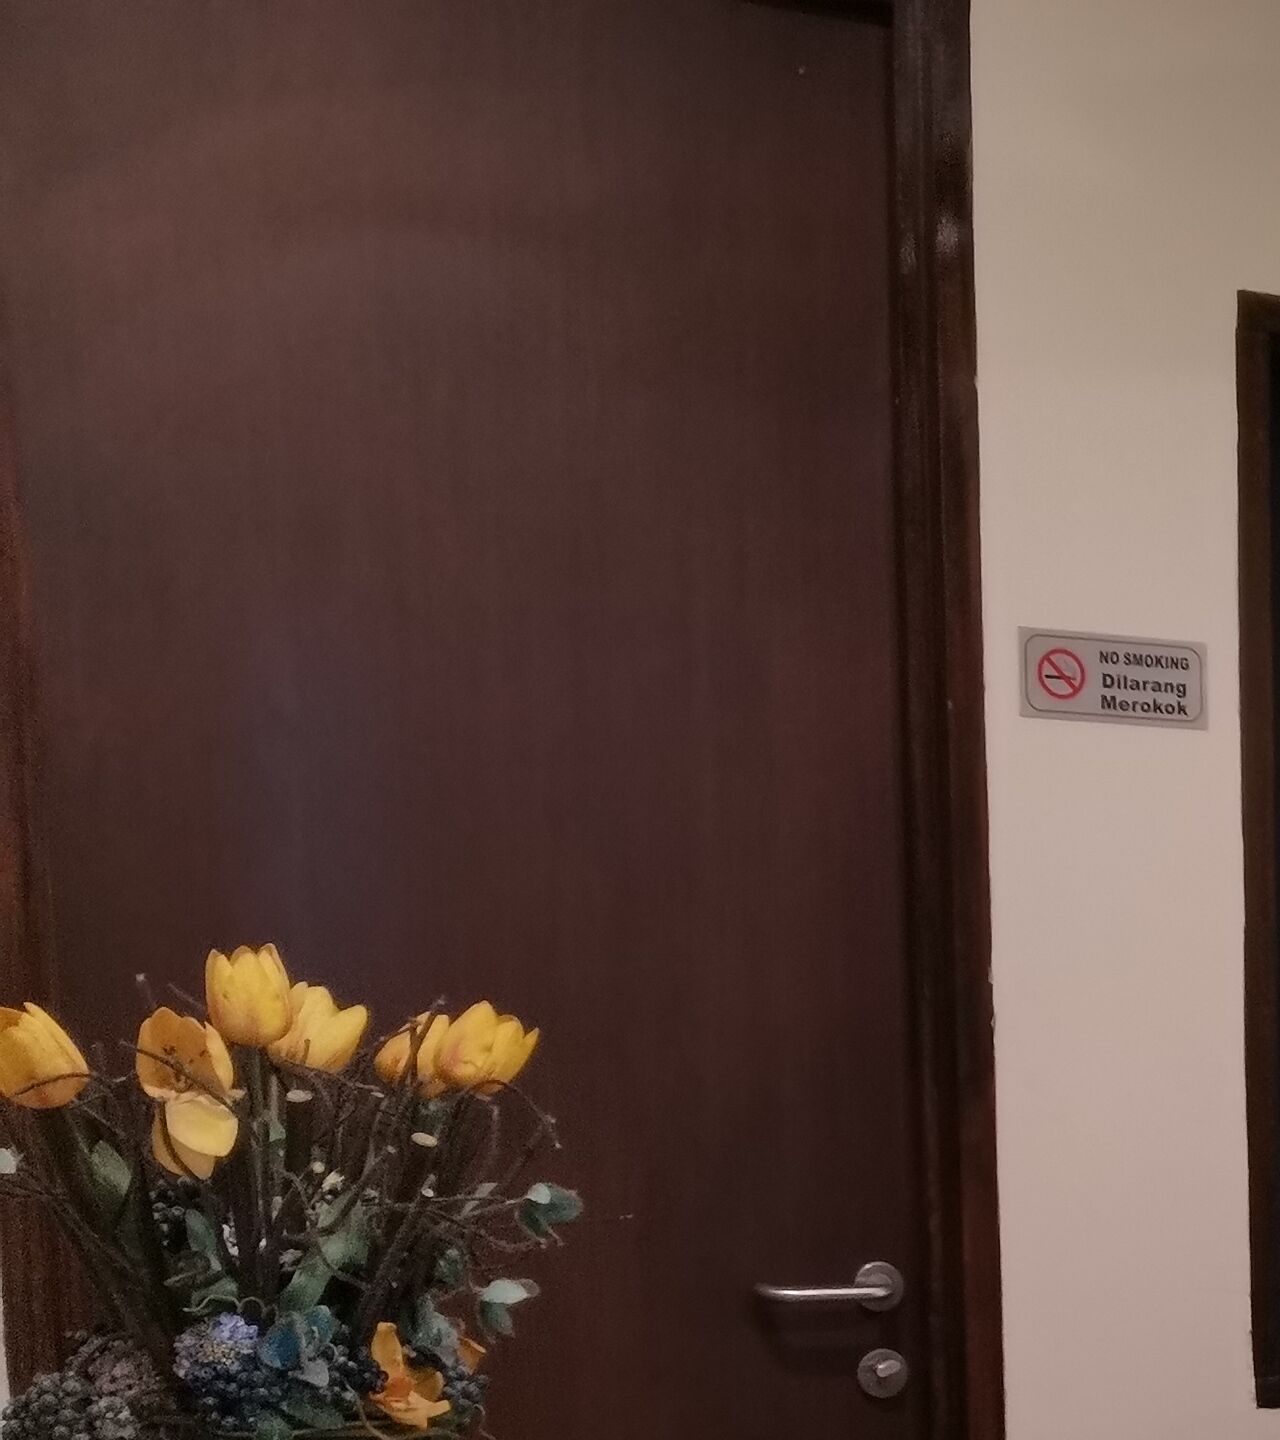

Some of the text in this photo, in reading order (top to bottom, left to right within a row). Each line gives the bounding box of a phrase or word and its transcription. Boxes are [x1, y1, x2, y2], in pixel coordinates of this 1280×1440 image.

[1099, 651, 1190, 671] NO SMOKING
[1102, 673, 1188, 698] Dilarang
[1100, 694, 1189, 717] Merokok
